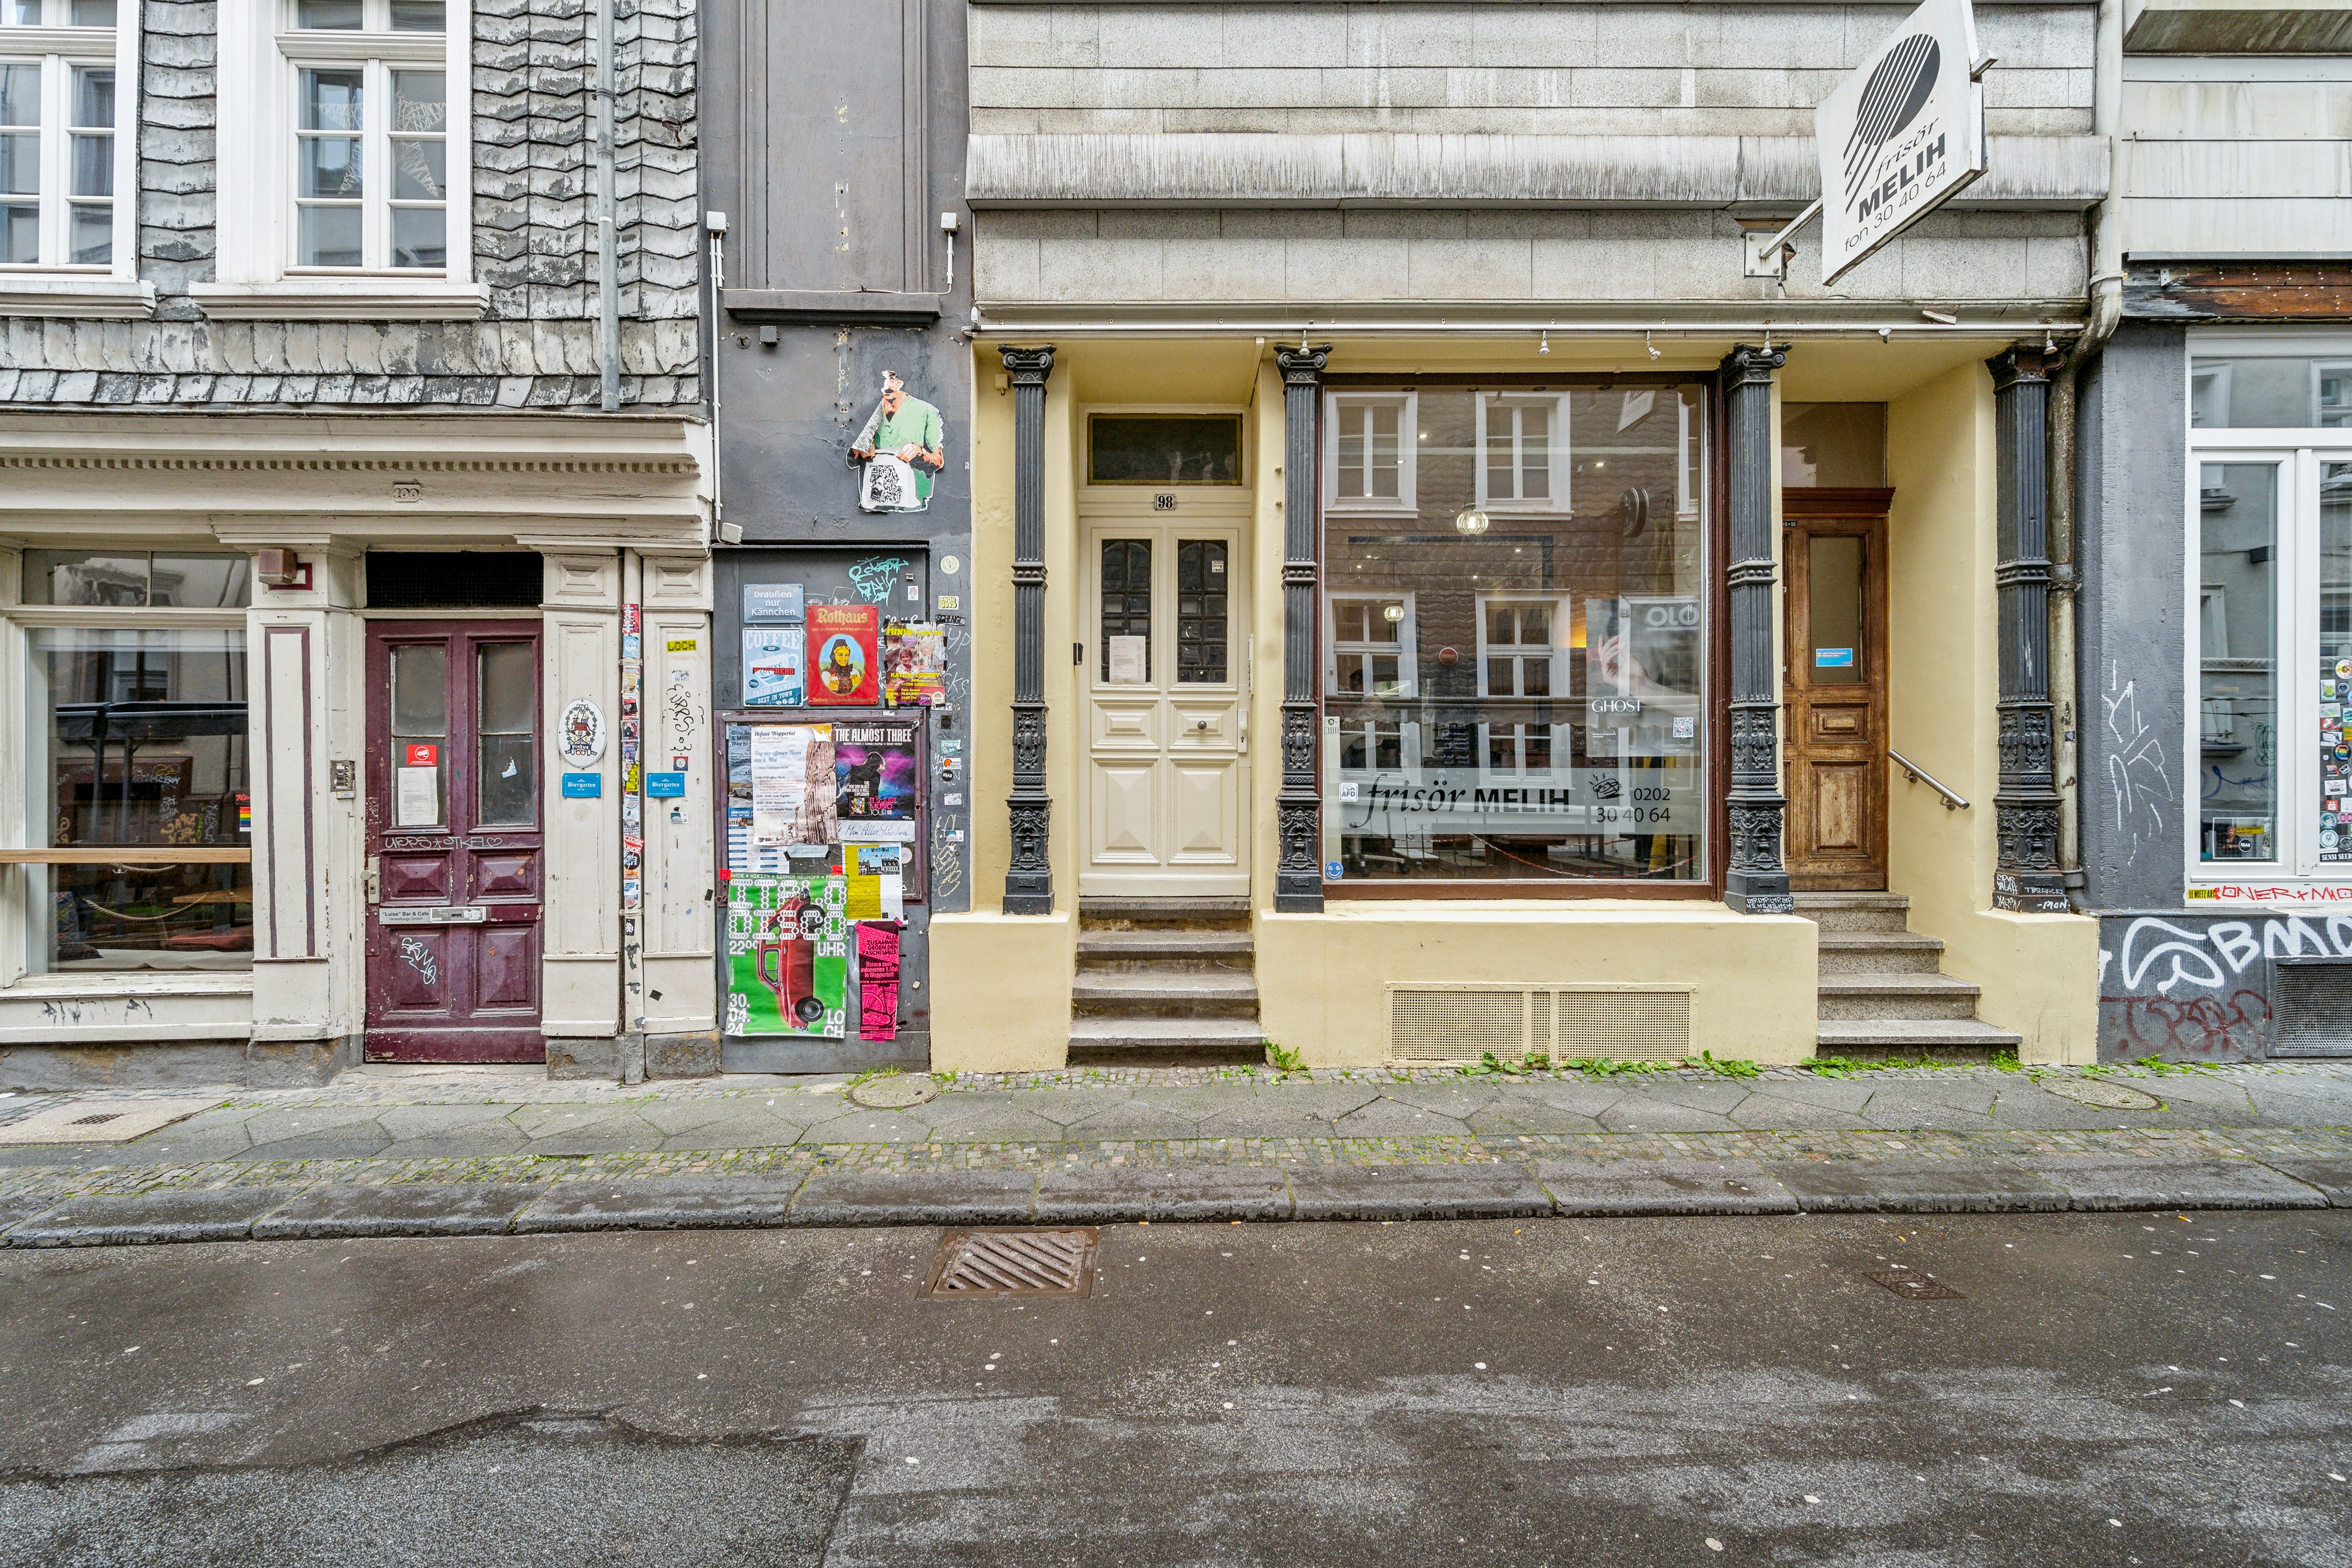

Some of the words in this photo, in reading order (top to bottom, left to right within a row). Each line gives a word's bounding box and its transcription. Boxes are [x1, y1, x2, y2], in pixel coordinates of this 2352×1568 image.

[1870, 117, 1939, 190] frisör
[1859, 133, 1946, 223] MELIH
[1845, 227, 1868, 251] fon
[1875, 204, 1893, 229] 30
[1899, 183, 1919, 207] 40
[1925, 161, 1946, 188] 64
[394, 488, 419, 499] 100
[1157, 495, 1173, 509] 98
[754, 590, 792, 598] Draußen
[751, 607, 795, 616] Kännchen
[816, 608, 869, 626] Rothaus
[667, 640, 696, 651] LOCH
[746, 631, 800, 650] COFFEE
[753, 686, 771, 697] FRESH
[773, 682, 796, 692] BREWED
[779, 690, 793, 699] TOWN
[1592, 699, 1643, 713] GHOST
[835, 729, 850, 742] THE
[851, 729, 884, 742] ALMOST
[886, 729, 912, 742] THREE
[1349, 773, 1465, 828] frisör
[1474, 789, 1570, 812] MELIH
[1634, 788, 1671, 801] 0202
[1596, 807, 1617, 823] 30
[1622, 807, 1643, 823] 40
[1649, 807, 1671, 823] 64
[729, 909, 847, 940] DISCO
[817, 942, 846, 956] UHR
[729, 993, 750, 1008] 30.
[729, 1007, 751, 1023] 04.
[827, 1009, 845, 1025] LO
[727, 1023, 744, 1035] 24
[823, 1025, 844, 1038] CH
